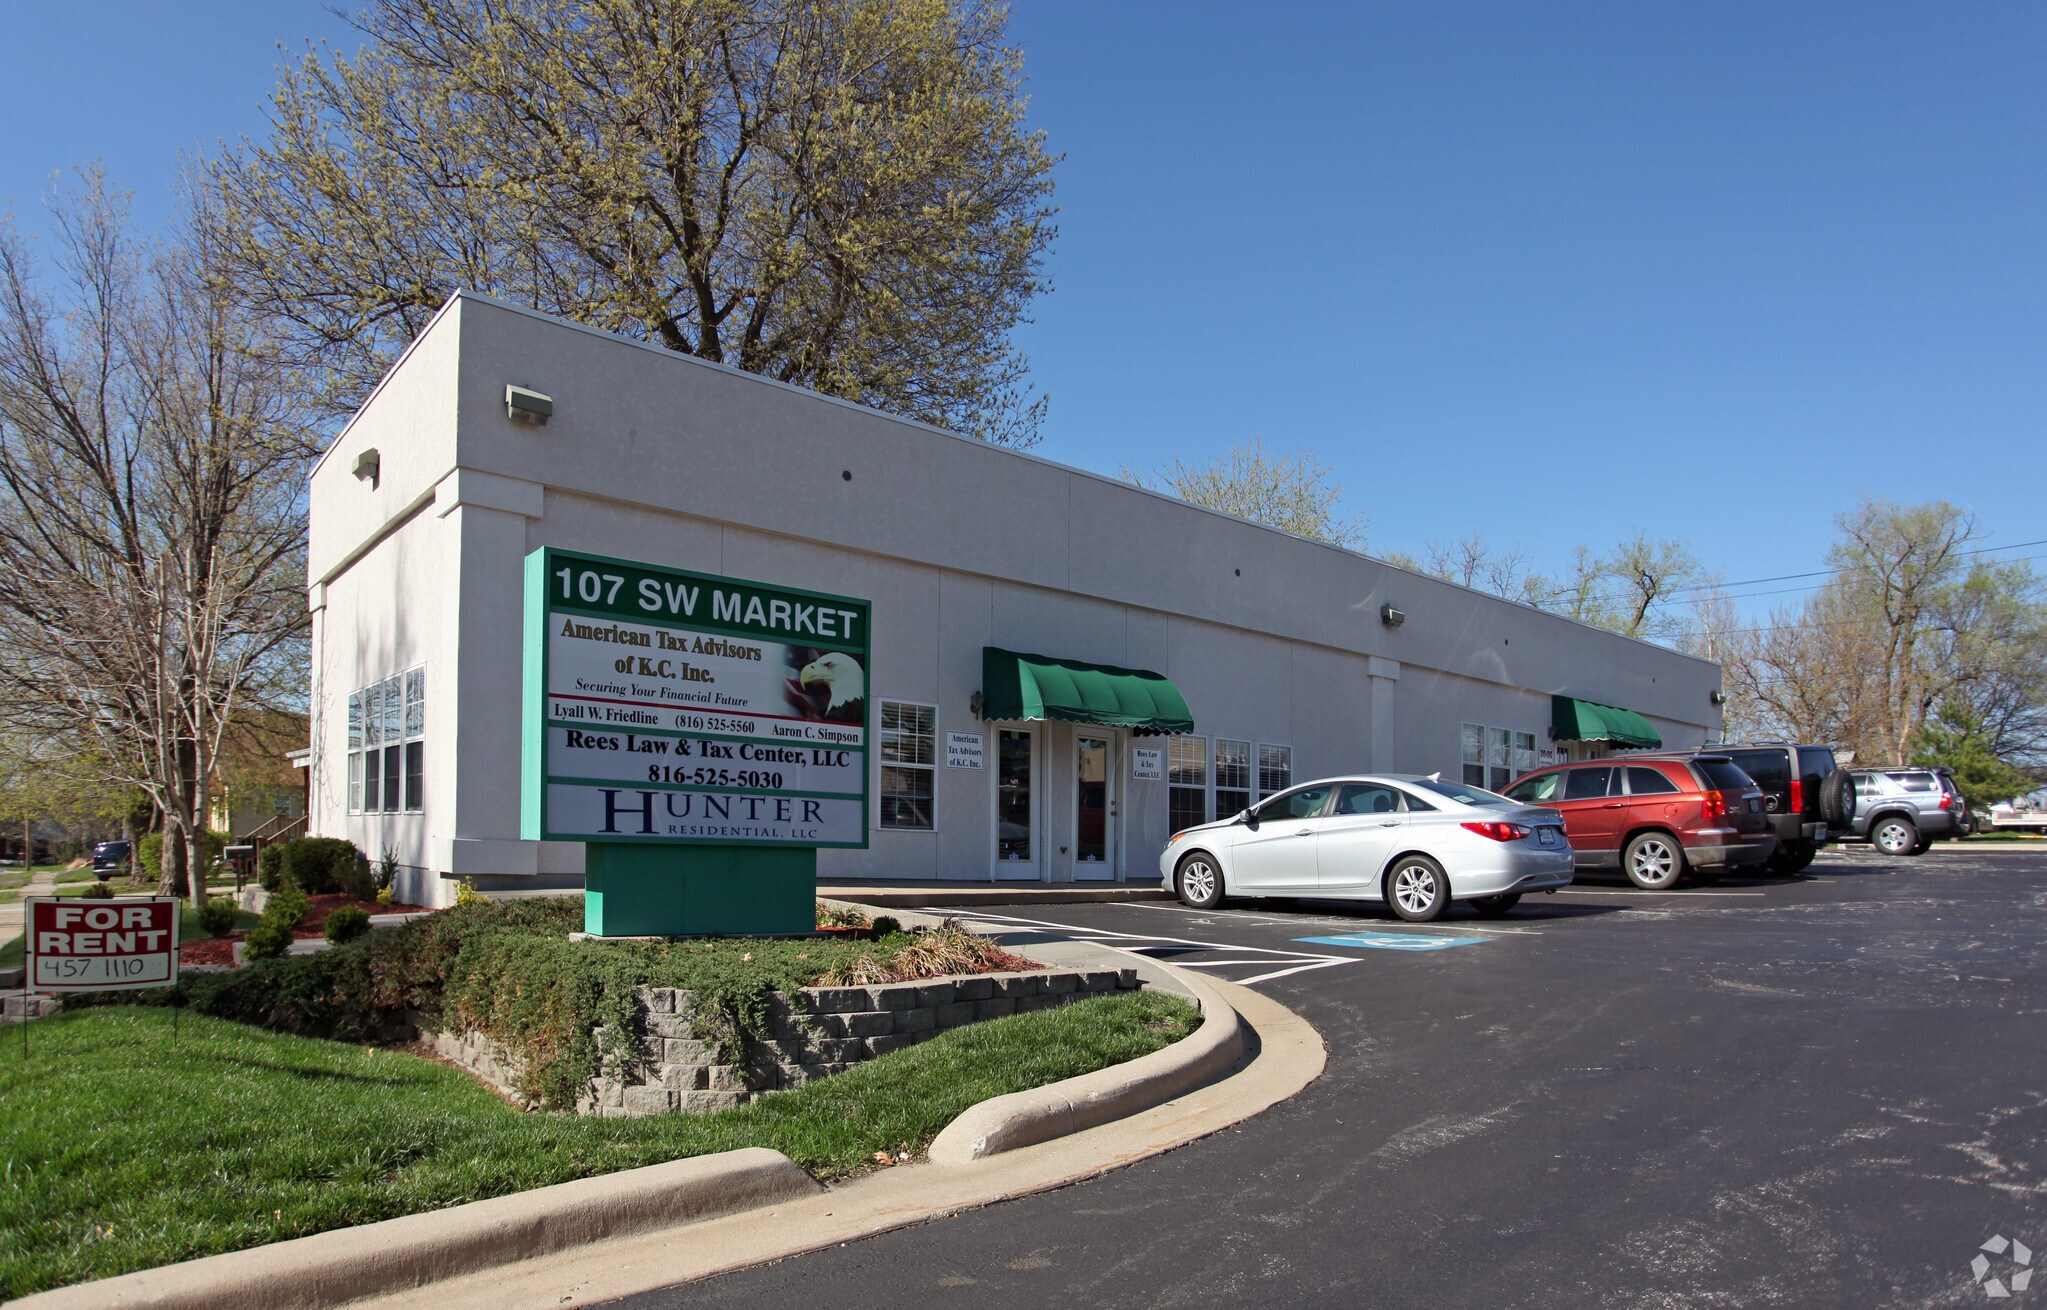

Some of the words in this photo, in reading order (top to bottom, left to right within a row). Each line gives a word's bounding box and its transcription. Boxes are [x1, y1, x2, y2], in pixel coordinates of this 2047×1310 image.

[556, 567, 625, 604] 107
[638, 578, 699, 616] SW
[712, 589, 858, 639] MARKET
[560, 618, 651, 647] American
[655, 630, 688, 652] Tax
[691, 636, 762, 661] Advisors
[614, 655, 635, 674] of
[637, 657, 676, 679] K.C.
[680, 662, 715, 683] Inc.
[575, 677, 627, 697] Securing
[630, 683, 657, 698] Your
[659, 686, 711, 703] Financial
[714, 692, 749, 707] Future
[554, 703, 584, 720] Lyall
[588, 706, 602, 720] W.
[605, 708, 659, 725] Friedline
[675, 714, 704, 731] (816)
[707, 717, 755, 734] 525-5560
[771, 723, 802, 738] Aaron
[804, 727, 815, 739] C.
[817, 727, 859, 743] Simpson
[952, 734, 979, 744] American
[565, 729, 619, 750] Rees
[626, 734, 670, 754] Law
[674, 738, 691, 756] &
[697, 740, 733, 759] Tax
[739, 743, 807, 767] Center,
[812, 750, 850, 767] LLC
[948, 746, 958, 754] Tax
[648, 764, 783, 789] 816-525-5030
[597, 788, 825, 835] HUNTER
[791, 829, 818, 839] LLC
[56, 907, 153, 930] FOR
[39, 930, 168, 954] RENT
